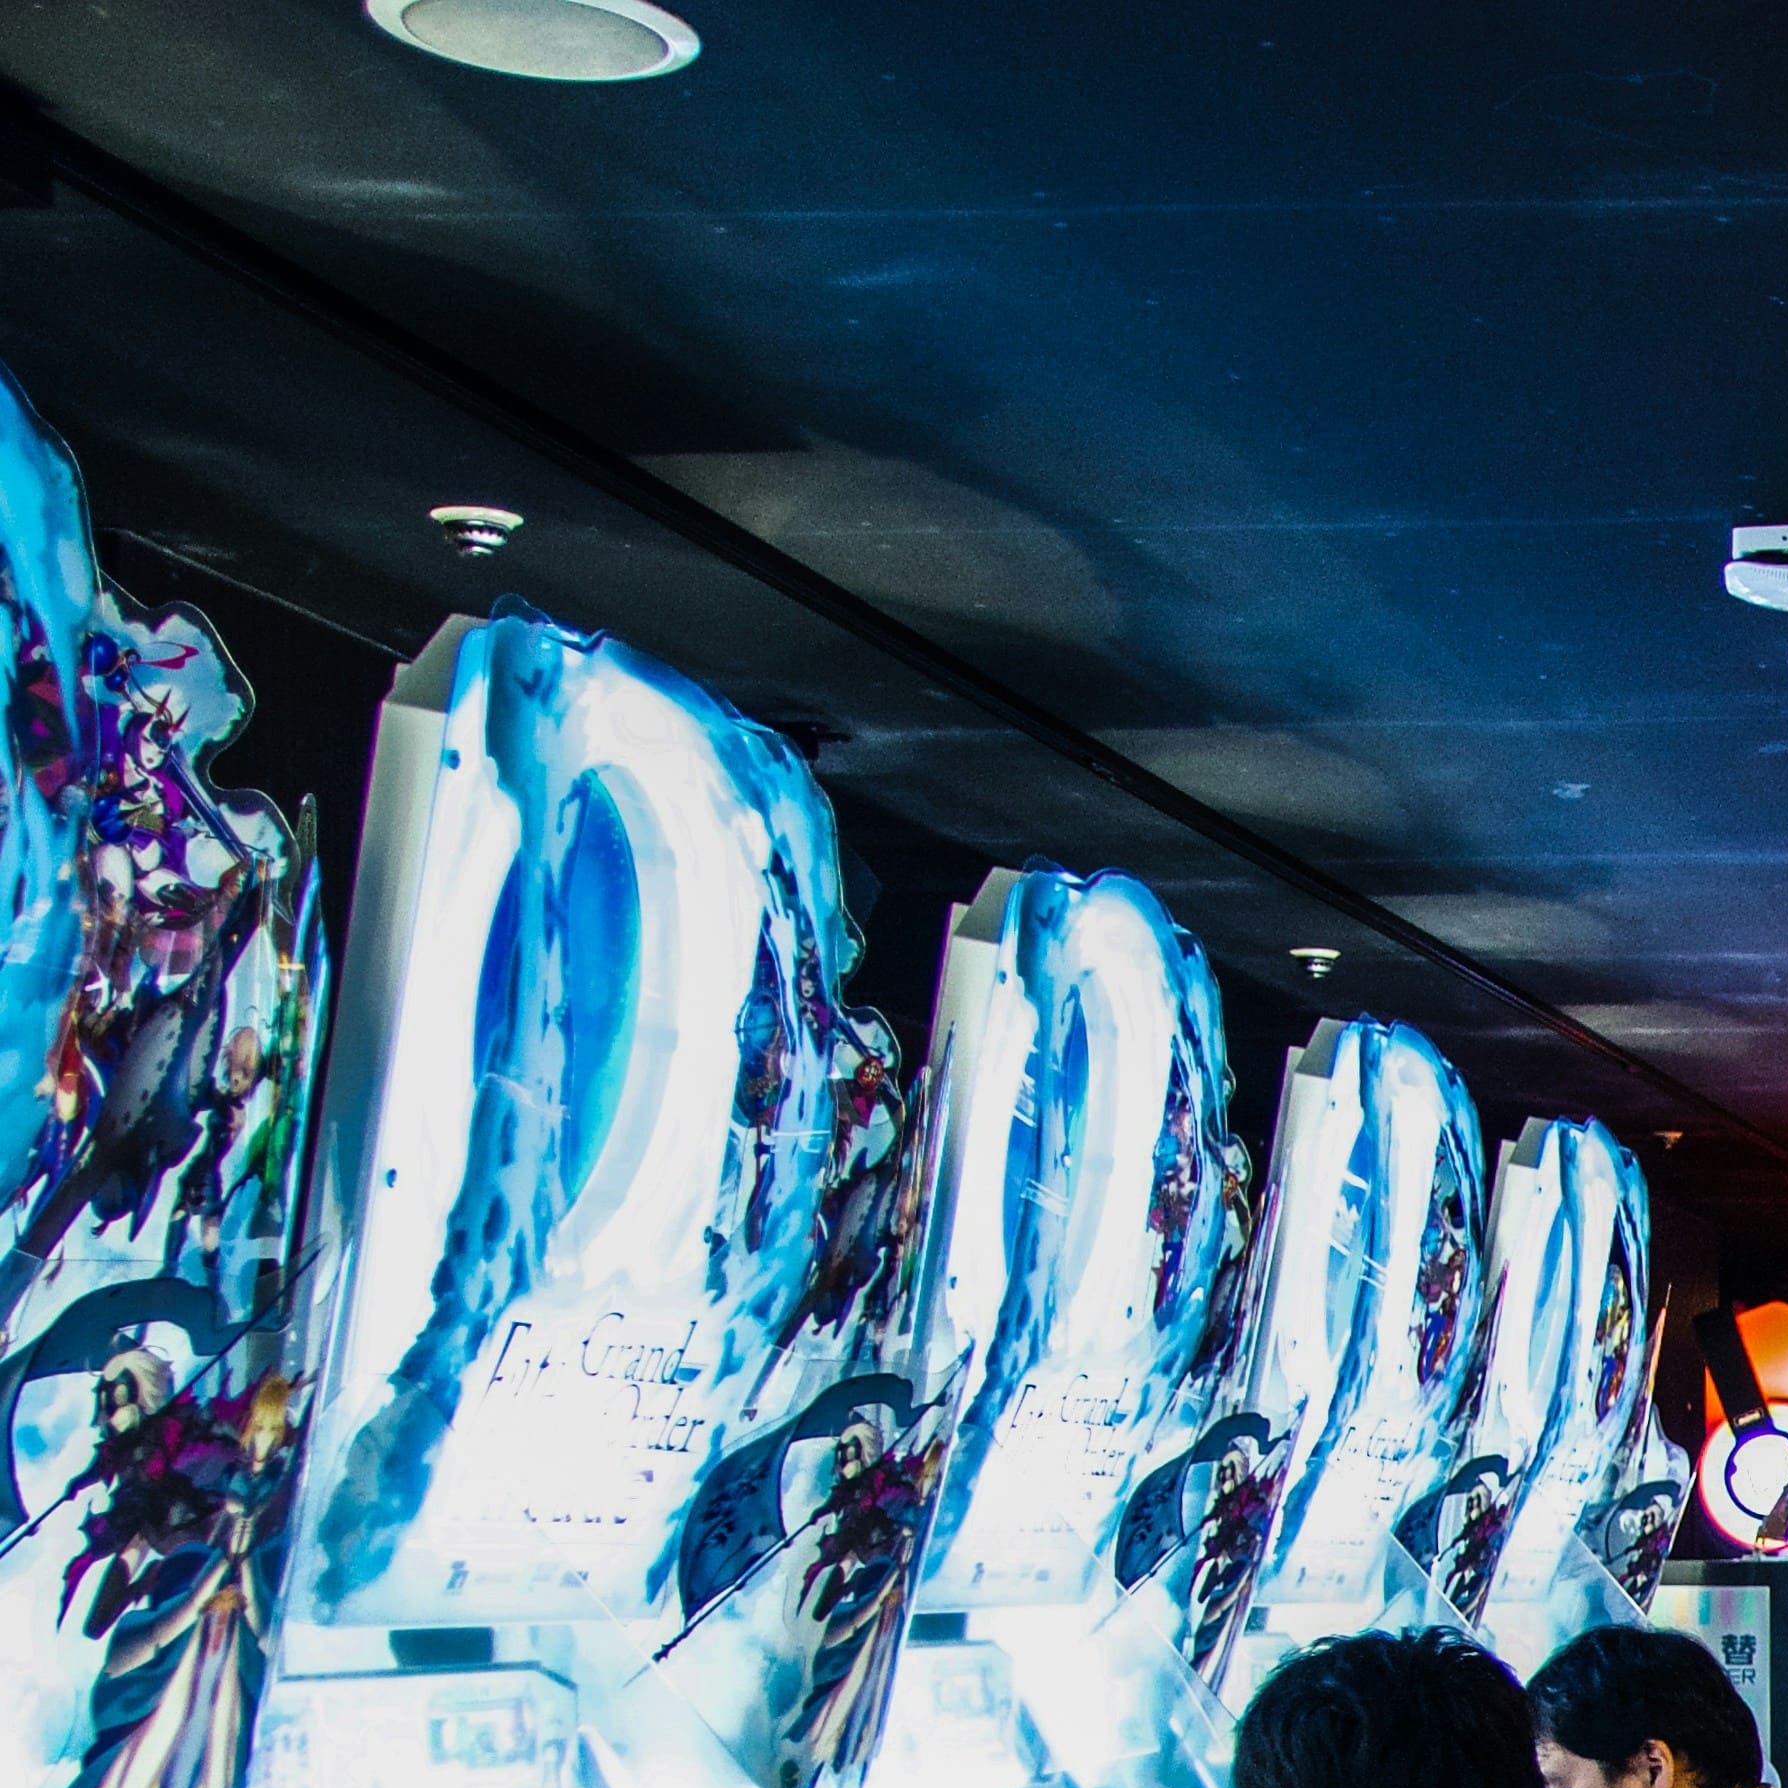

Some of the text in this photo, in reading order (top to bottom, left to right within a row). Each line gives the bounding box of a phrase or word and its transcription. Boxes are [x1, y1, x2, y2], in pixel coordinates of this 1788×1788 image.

[581, 1312, 698, 1385] Grand
[1721, 1633, 1757, 1666] 替
[1727, 1668, 1757, 1685] ER
